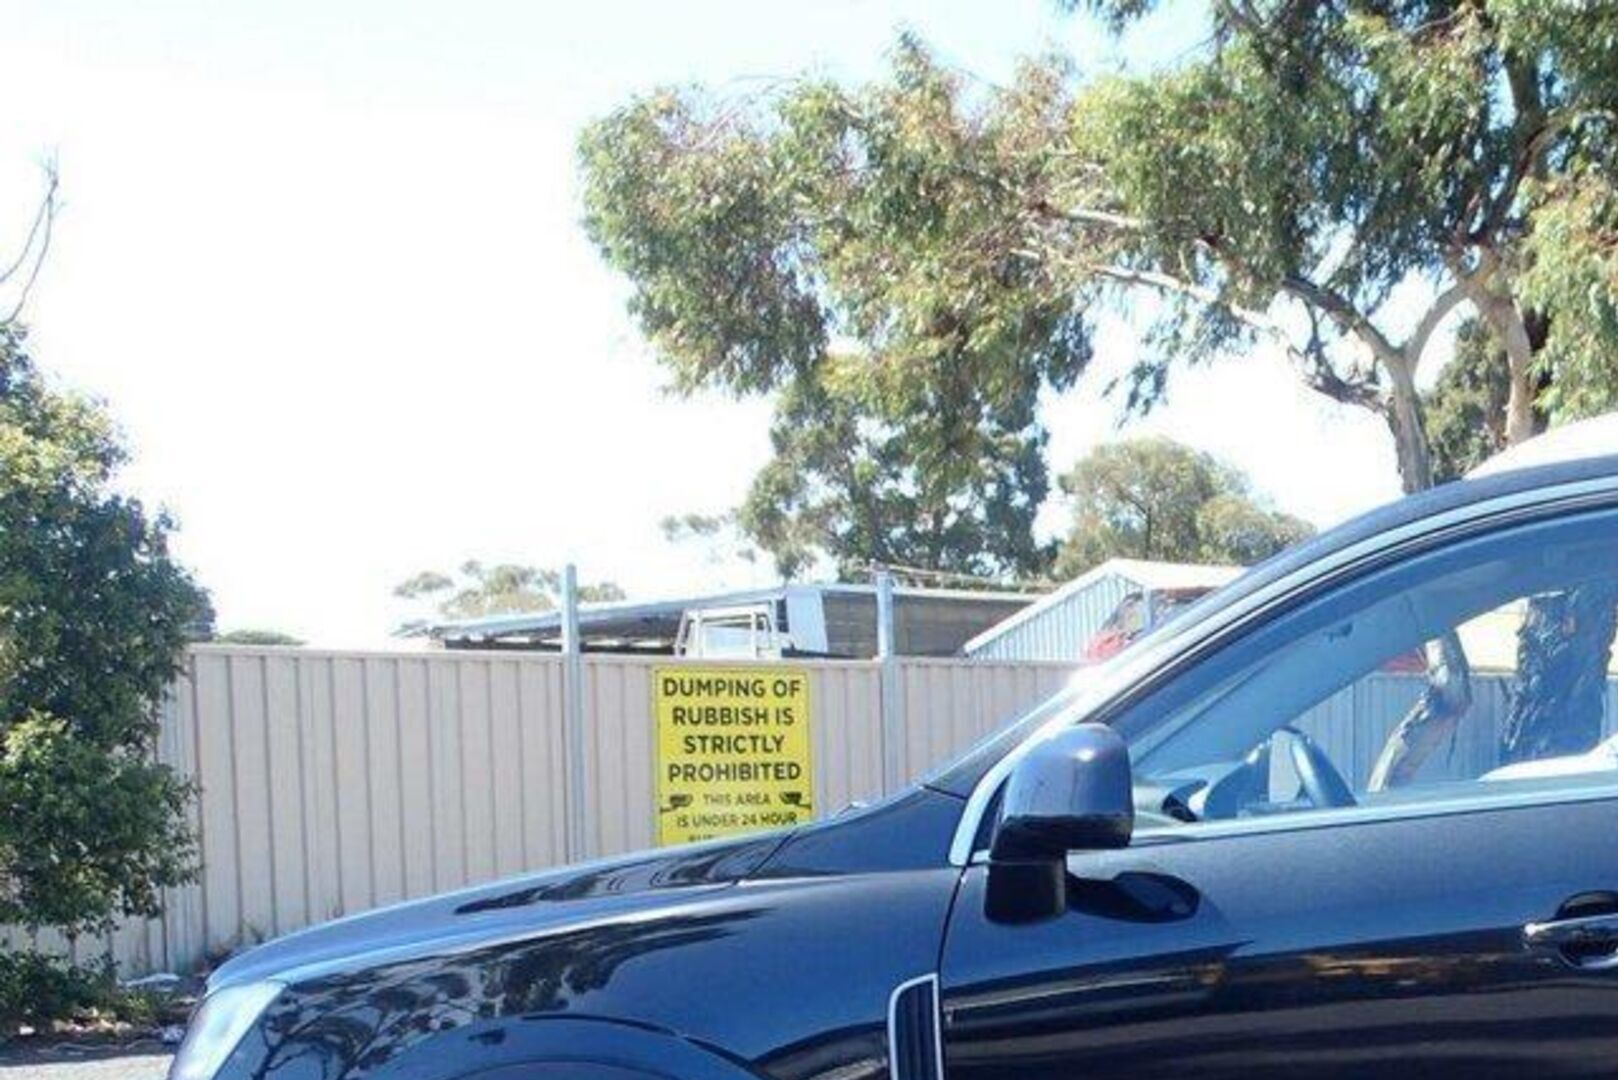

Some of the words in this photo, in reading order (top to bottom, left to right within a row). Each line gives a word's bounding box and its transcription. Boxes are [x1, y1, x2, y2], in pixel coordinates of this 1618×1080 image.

[663, 678, 766, 698] DUMPING
[773, 679, 801, 698] OF
[672, 706, 768, 726] RUBBISH
[775, 707, 795, 726] IS
[684, 735, 785, 754] STRICTLY
[668, 762, 802, 782] PROHIBITED
[703, 793, 732, 805] THIS
[736, 793, 771, 805] AREA
[677, 814, 689, 828] IS
[692, 813, 738, 828] UNDER
[741, 814, 758, 827] 24
[760, 811, 798, 826] HOUR
